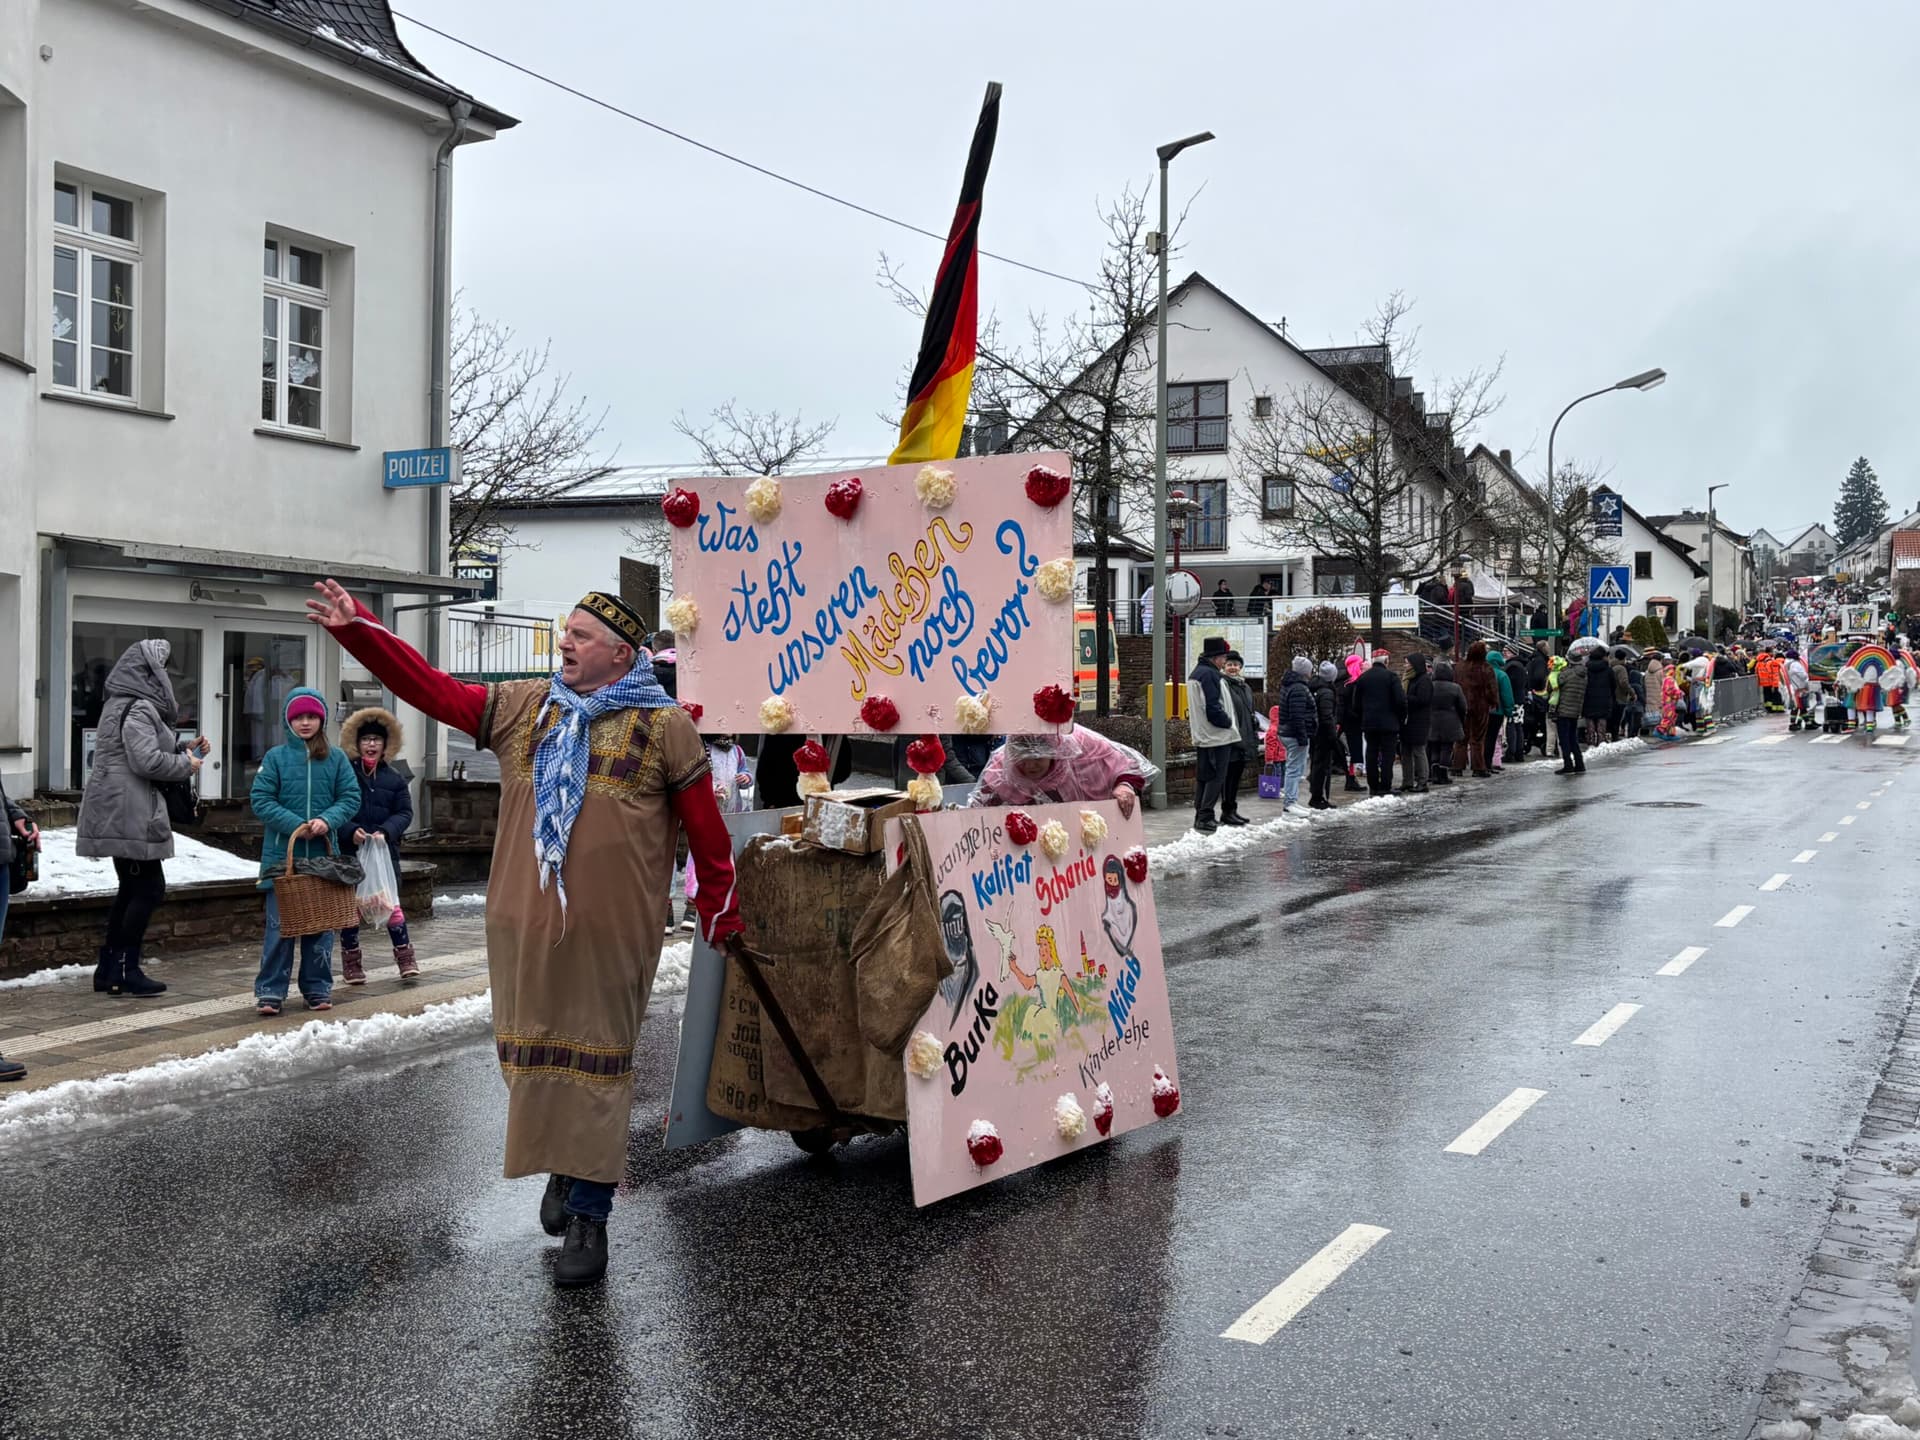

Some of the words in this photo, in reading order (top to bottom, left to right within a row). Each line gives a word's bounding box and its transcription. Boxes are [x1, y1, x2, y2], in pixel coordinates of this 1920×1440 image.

[389, 455, 445, 479] POLIZEI
[697, 501, 759, 553] Was
[457, 568, 494, 580] KINO
[722, 540, 806, 642] steht
[767, 565, 878, 695] unseren
[840, 516, 974, 701] Mädchen
[908, 565, 975, 682] noch
[1351, 605, 1415, 619] Willmmen
[972, 849, 1033, 911] Kalifat
[1035, 848, 1097, 916] Scharia
